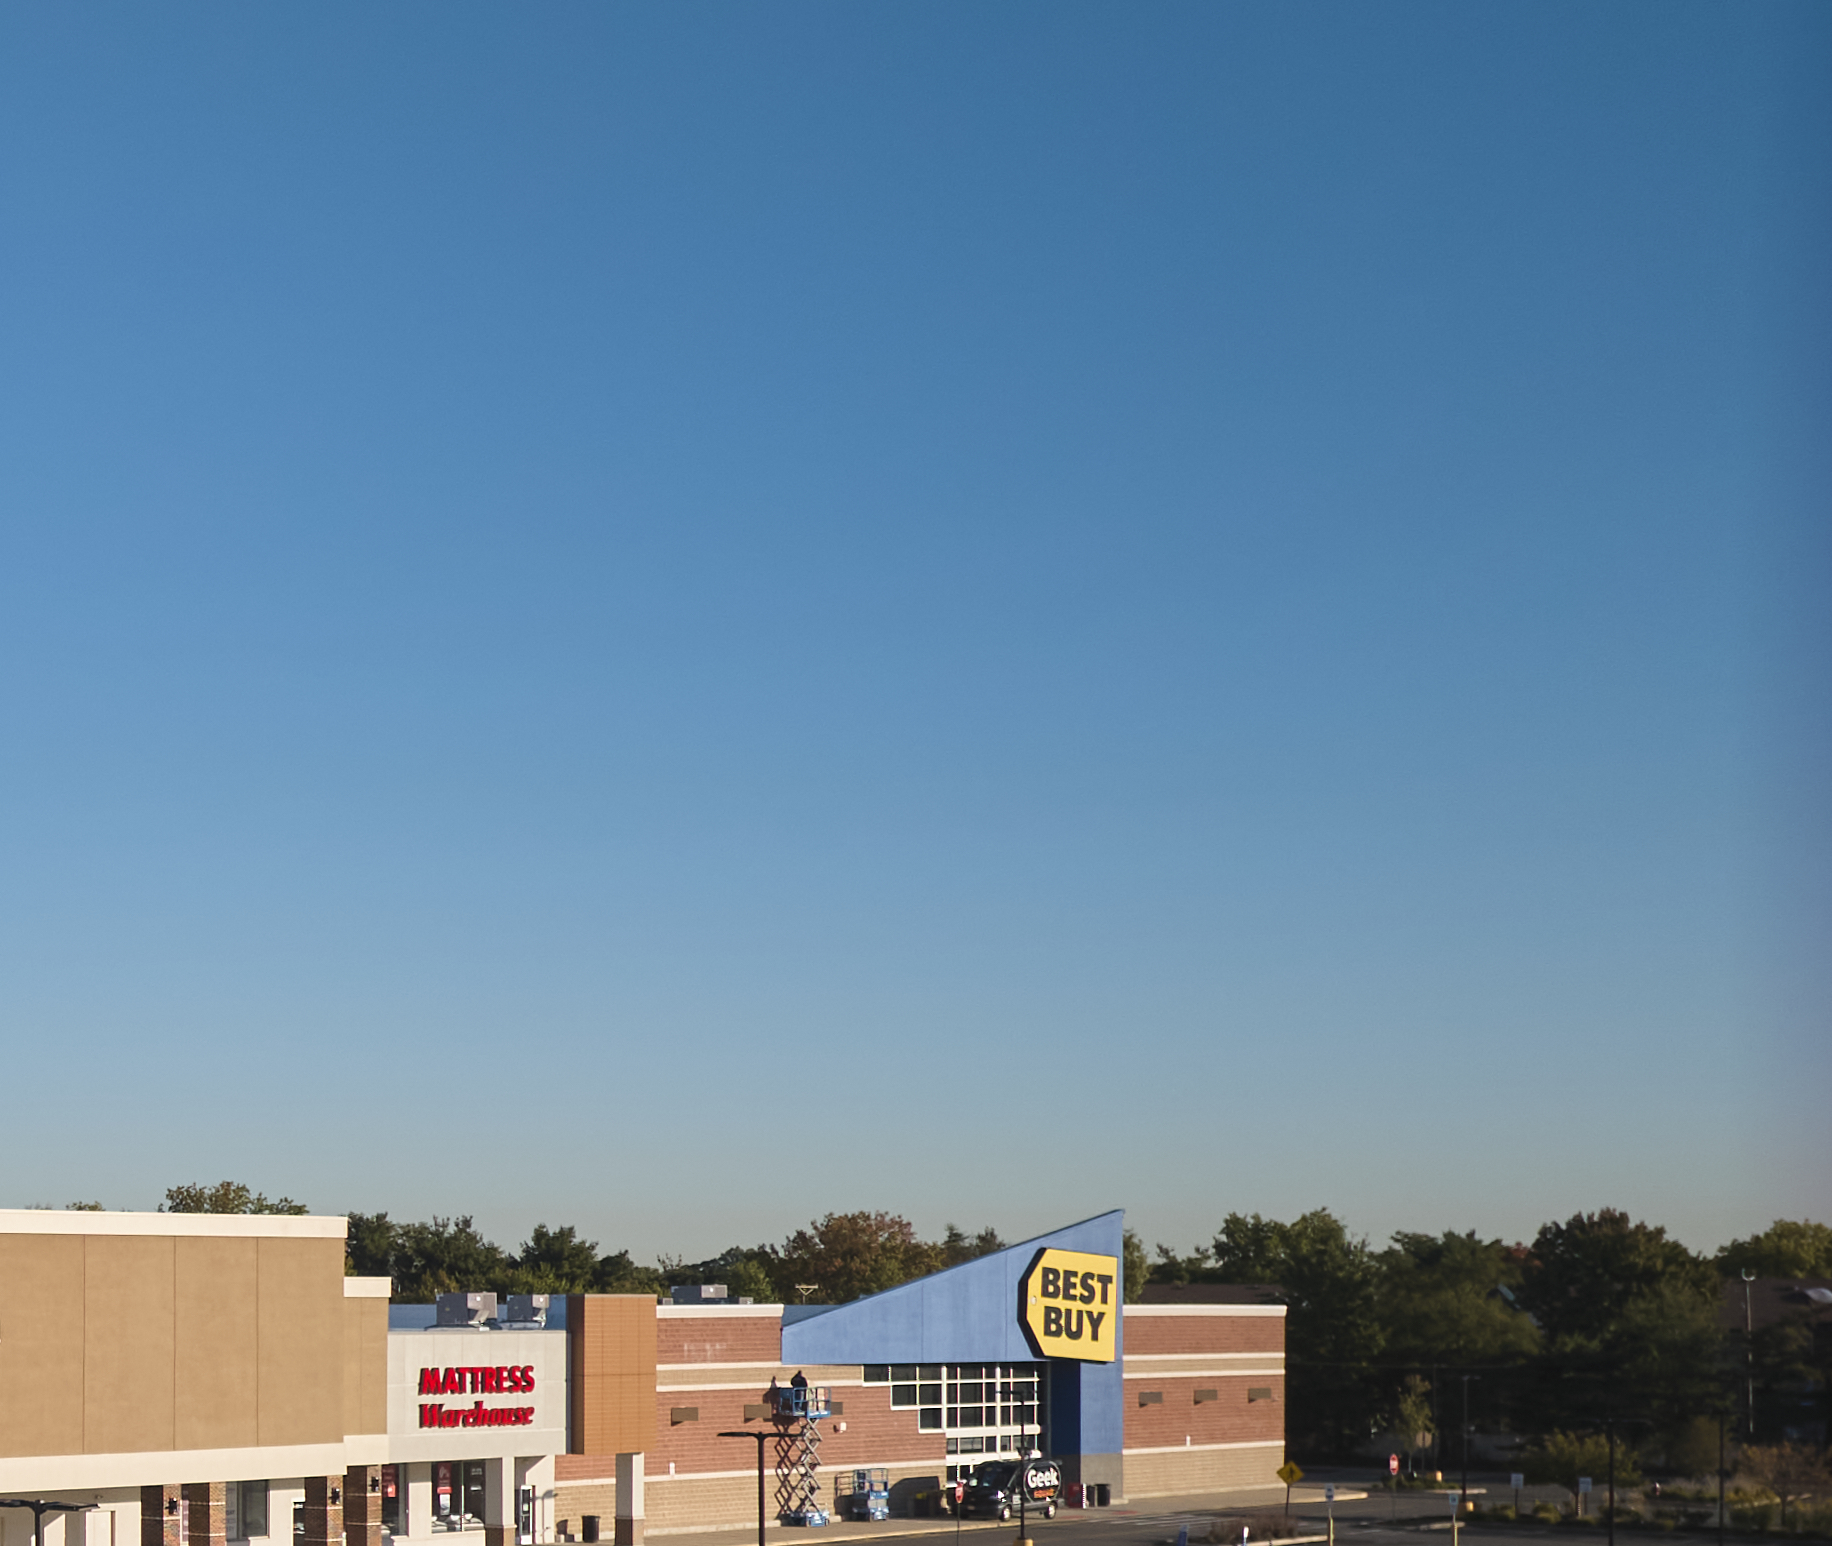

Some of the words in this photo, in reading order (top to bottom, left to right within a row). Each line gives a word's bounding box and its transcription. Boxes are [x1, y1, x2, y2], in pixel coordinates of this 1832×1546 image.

[1041, 1266, 1113, 1305] BEST
[1043, 1306, 1106, 1342] BUY
[418, 1365, 535, 1395] MATTRESS
[418, 1401, 535, 1428] Warehouse
[1027, 1467, 1059, 1489] Geek
